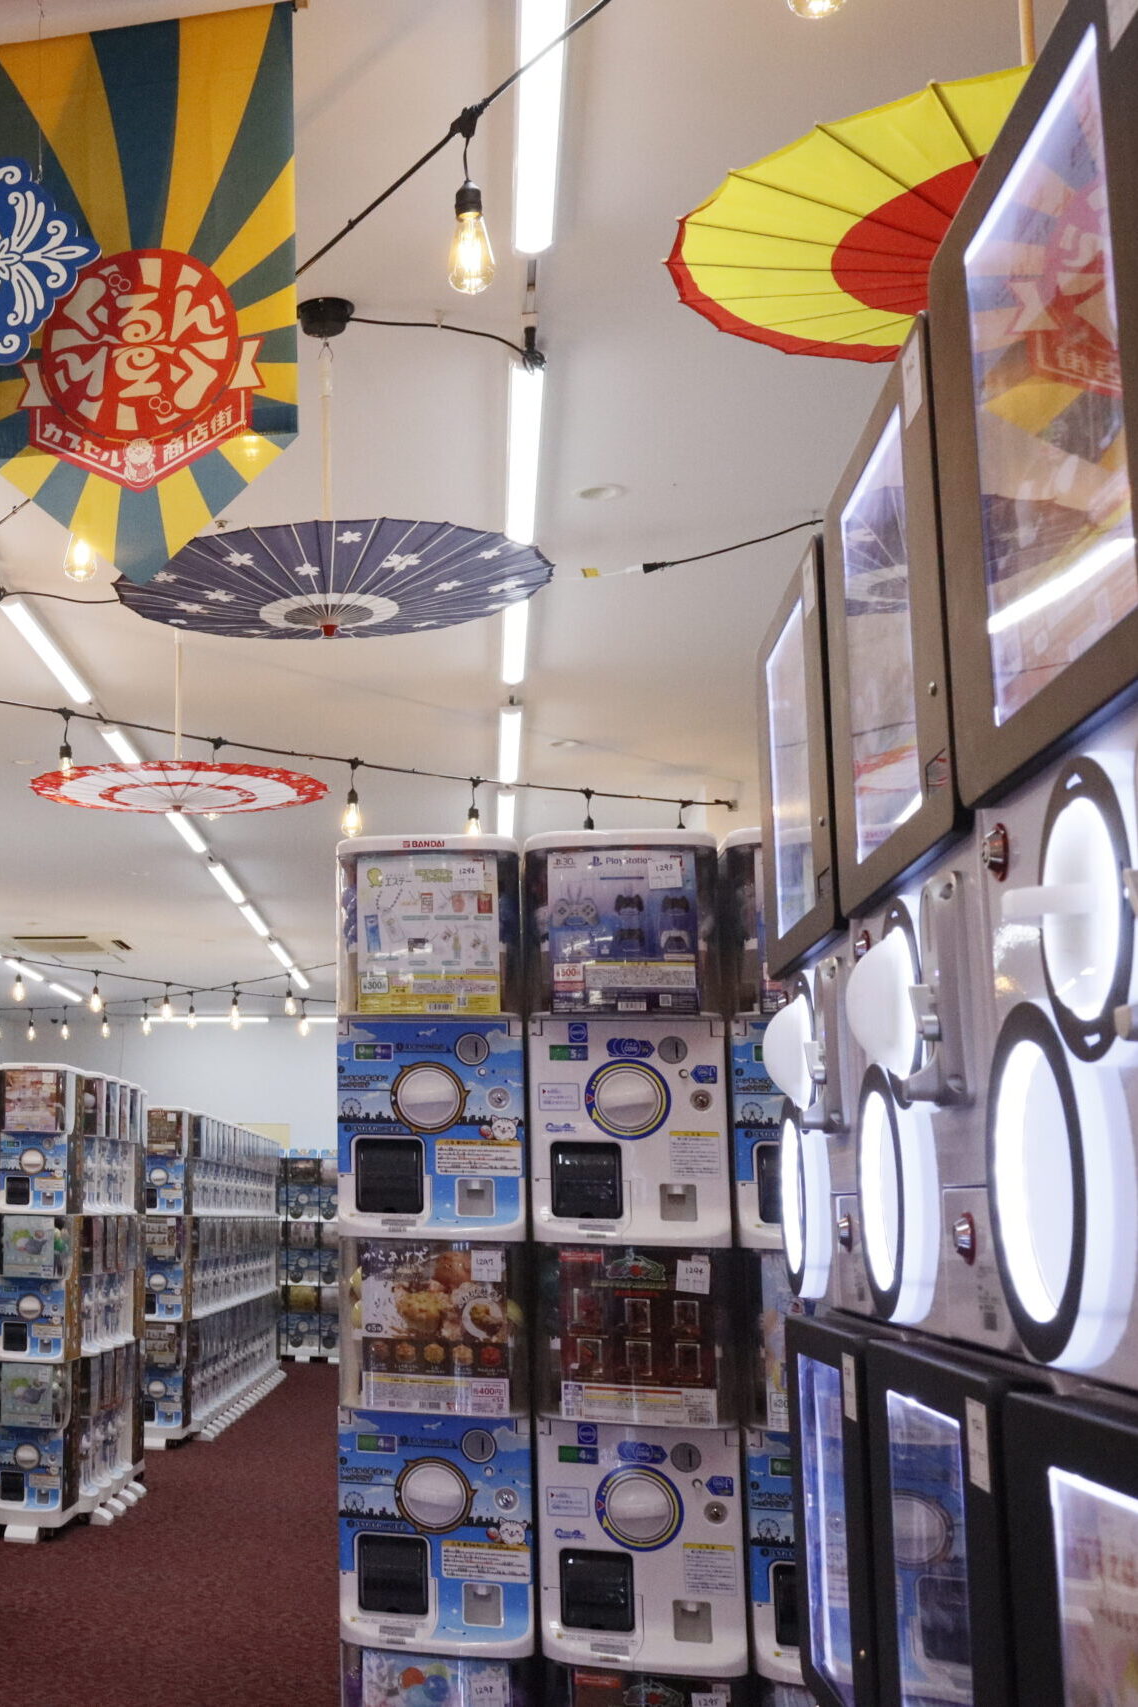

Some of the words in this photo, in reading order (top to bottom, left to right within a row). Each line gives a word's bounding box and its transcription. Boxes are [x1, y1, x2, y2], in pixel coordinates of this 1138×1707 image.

[42, 422, 122, 468] カプセル
[162, 404, 233, 463] 商店街
[412, 840, 445, 848] BANDAI
